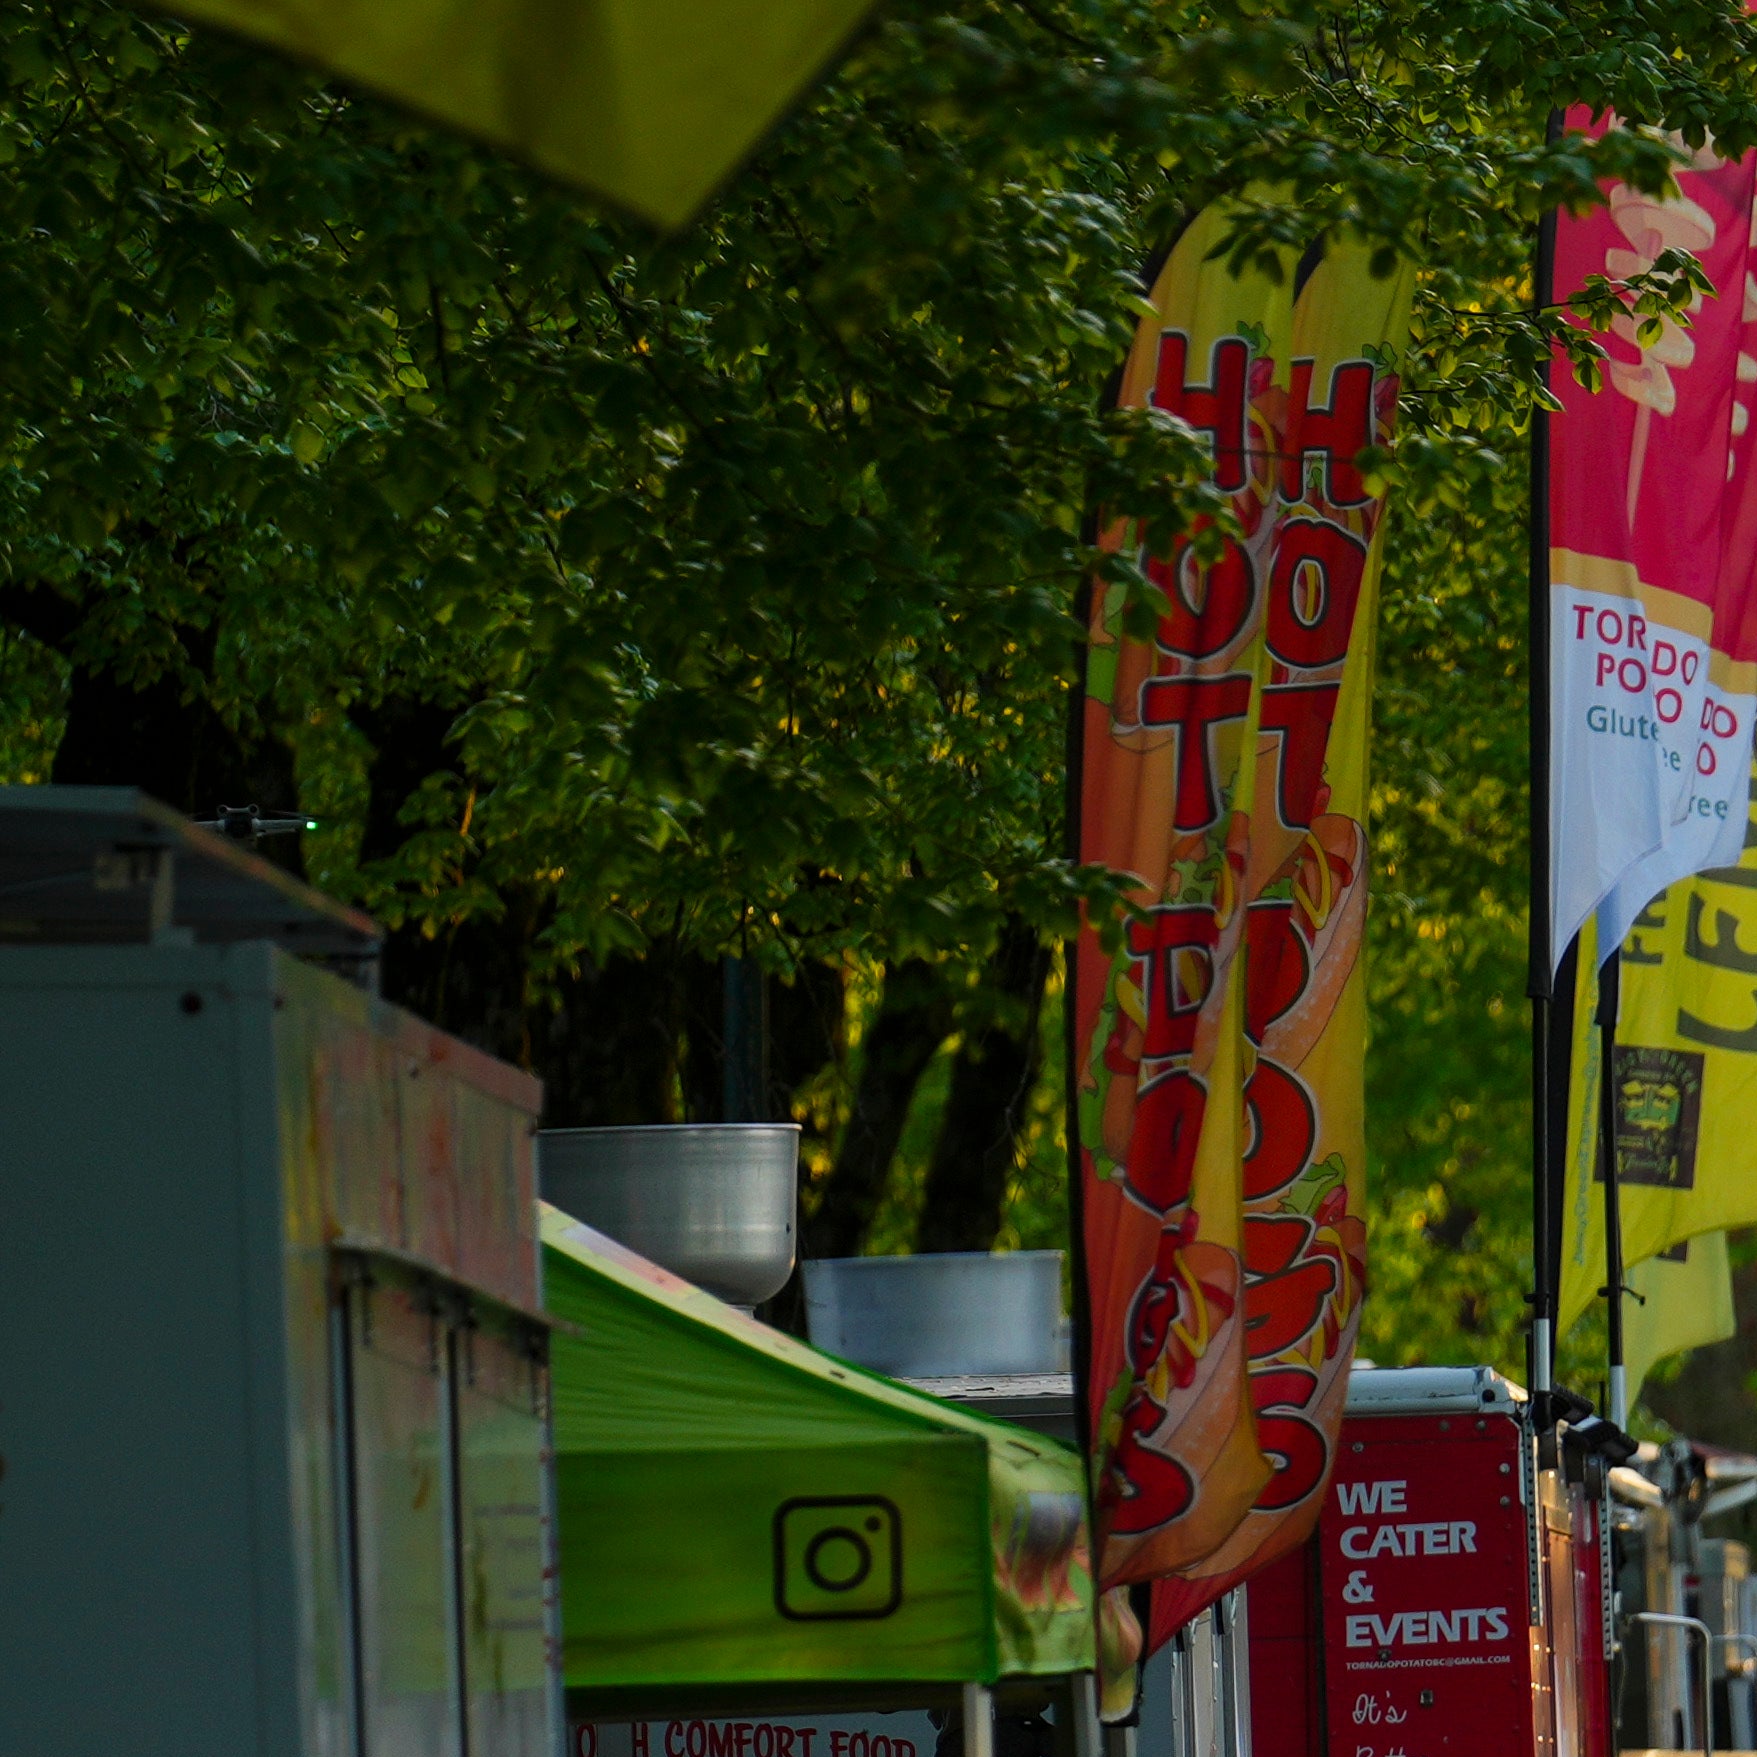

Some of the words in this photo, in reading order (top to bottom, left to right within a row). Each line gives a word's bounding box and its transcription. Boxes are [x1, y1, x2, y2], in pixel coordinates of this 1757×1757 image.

[1336, 1480, 1408, 1516] WE
[1339, 1520, 1478, 1560] CATER
[1342, 1569, 1376, 1604] &
[1345, 1606, 1510, 1649] EVENTS
[1352, 1689, 1408, 1725] It's
